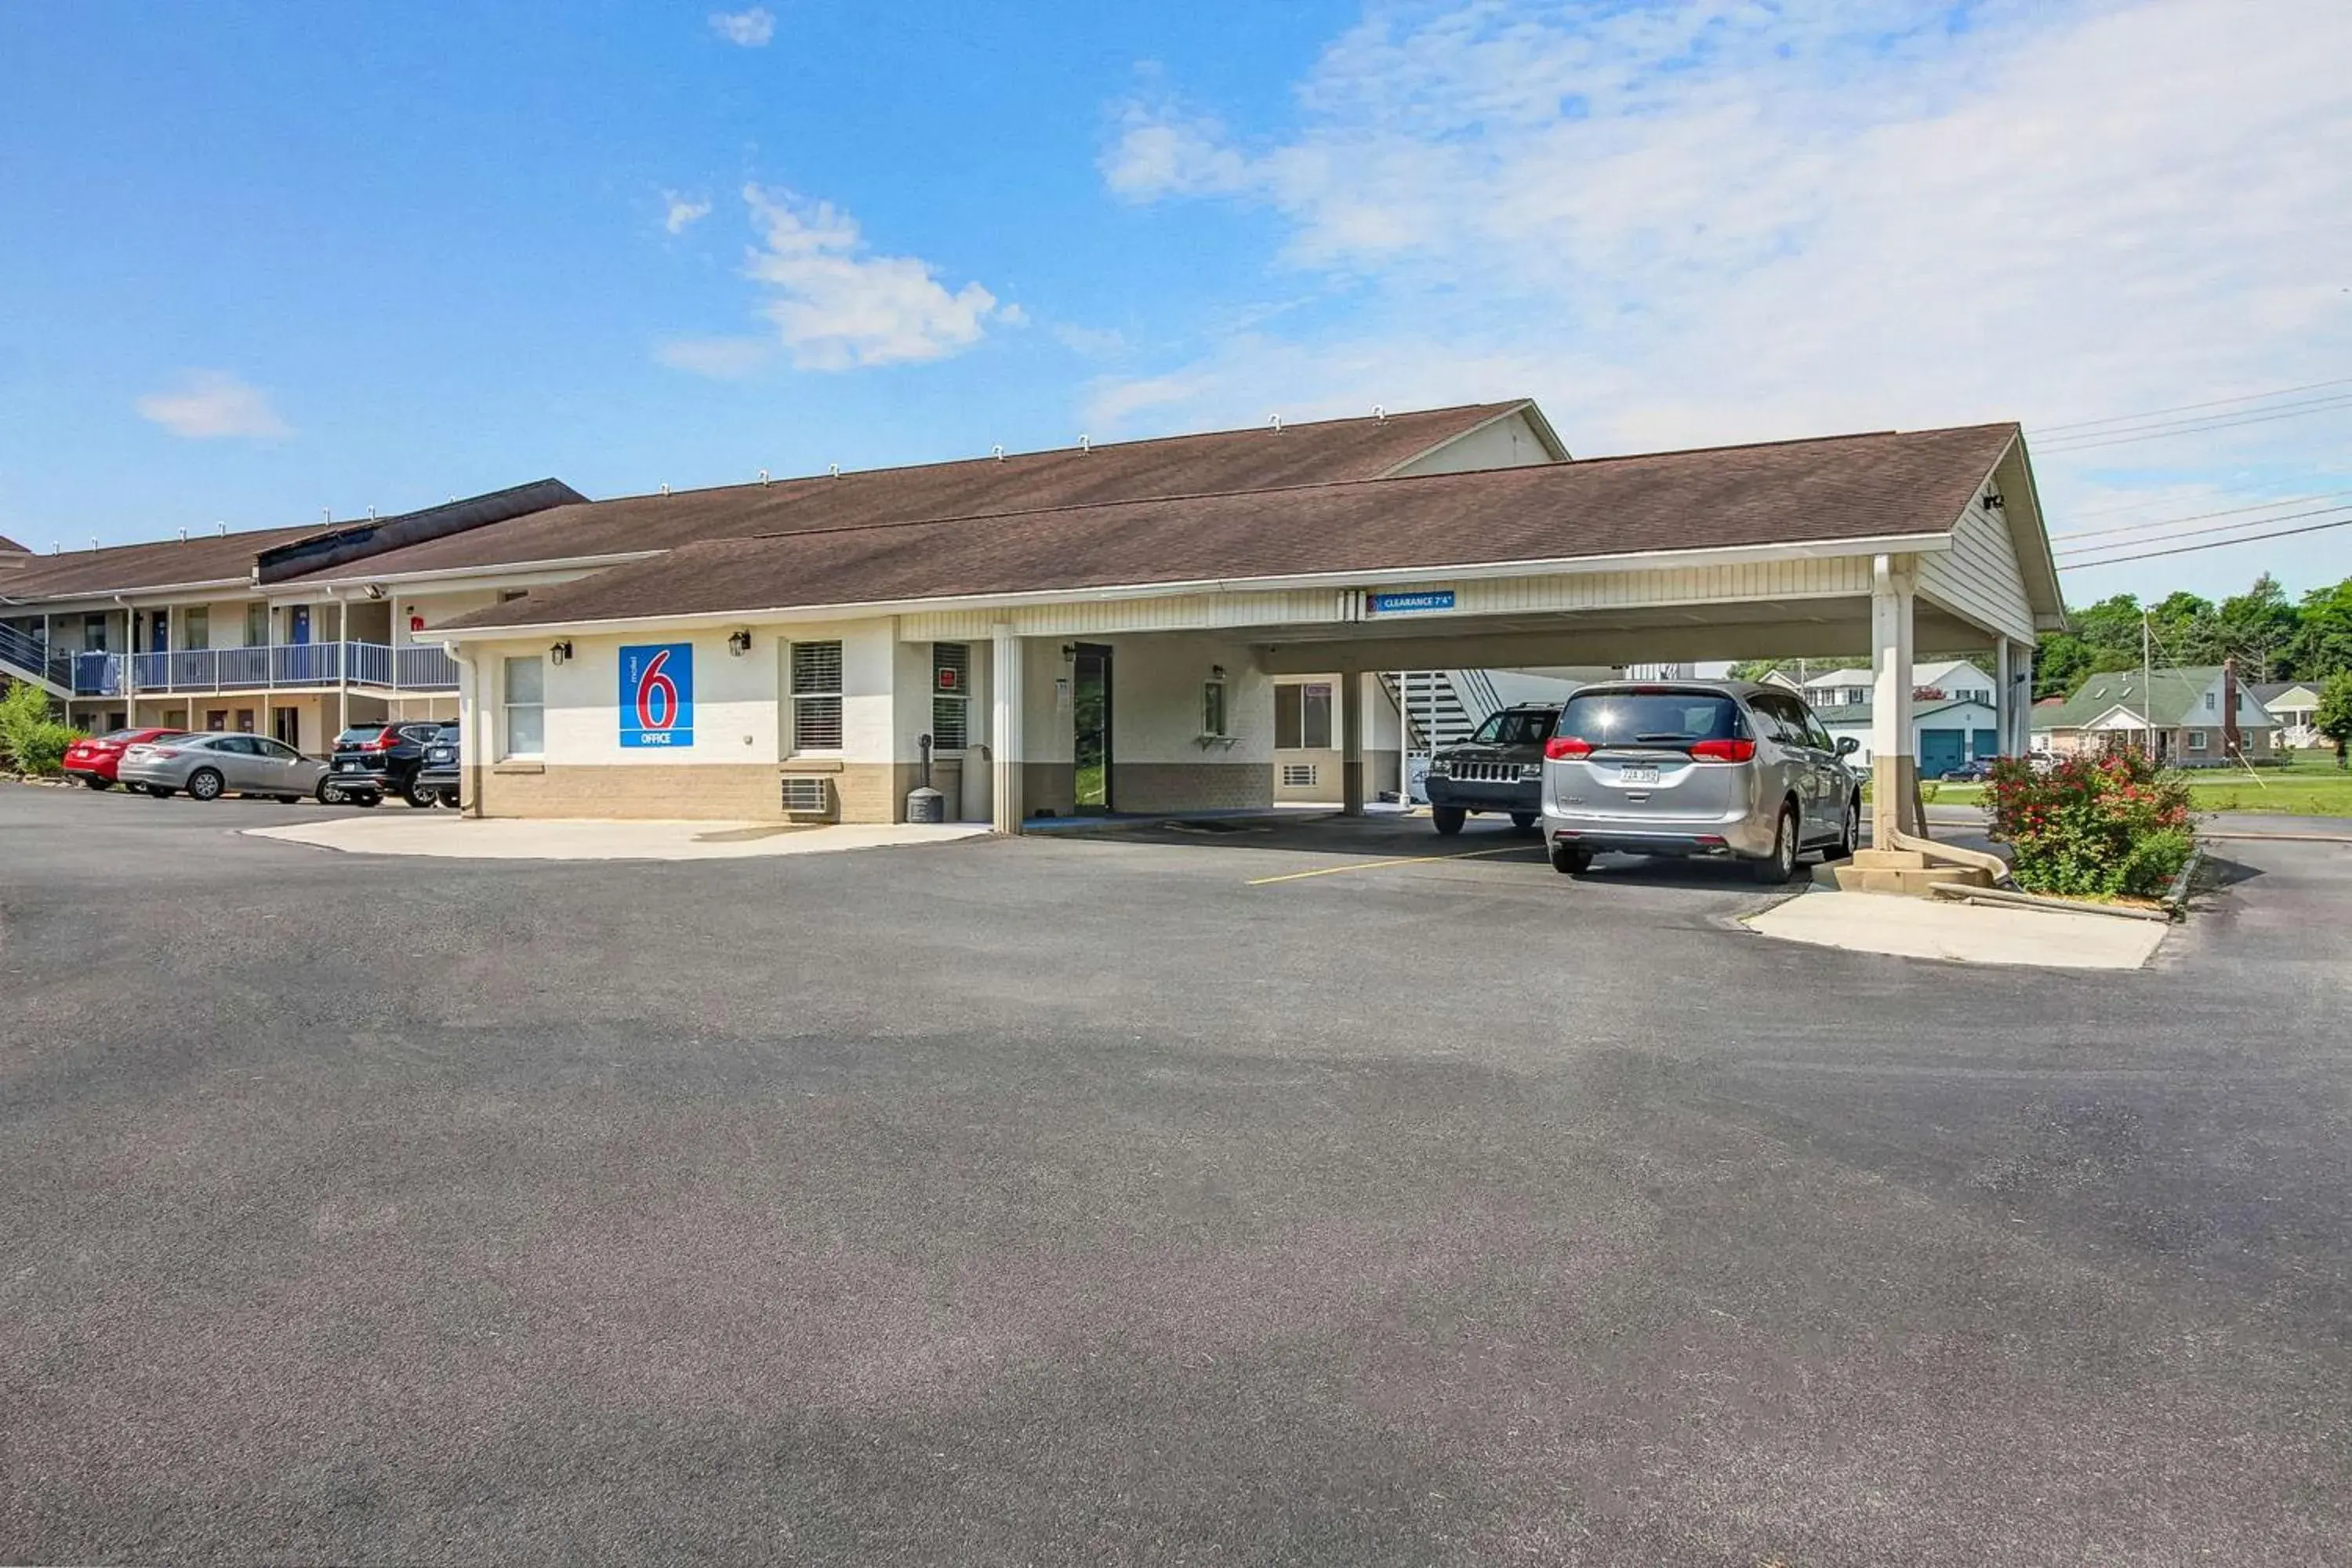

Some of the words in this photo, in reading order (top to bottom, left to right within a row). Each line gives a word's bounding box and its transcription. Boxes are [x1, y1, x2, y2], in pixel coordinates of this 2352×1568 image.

[1385, 597, 1432, 608] CLEARANCE
[636, 650, 678, 731] 6
[641, 733, 671, 744] OFFICE
